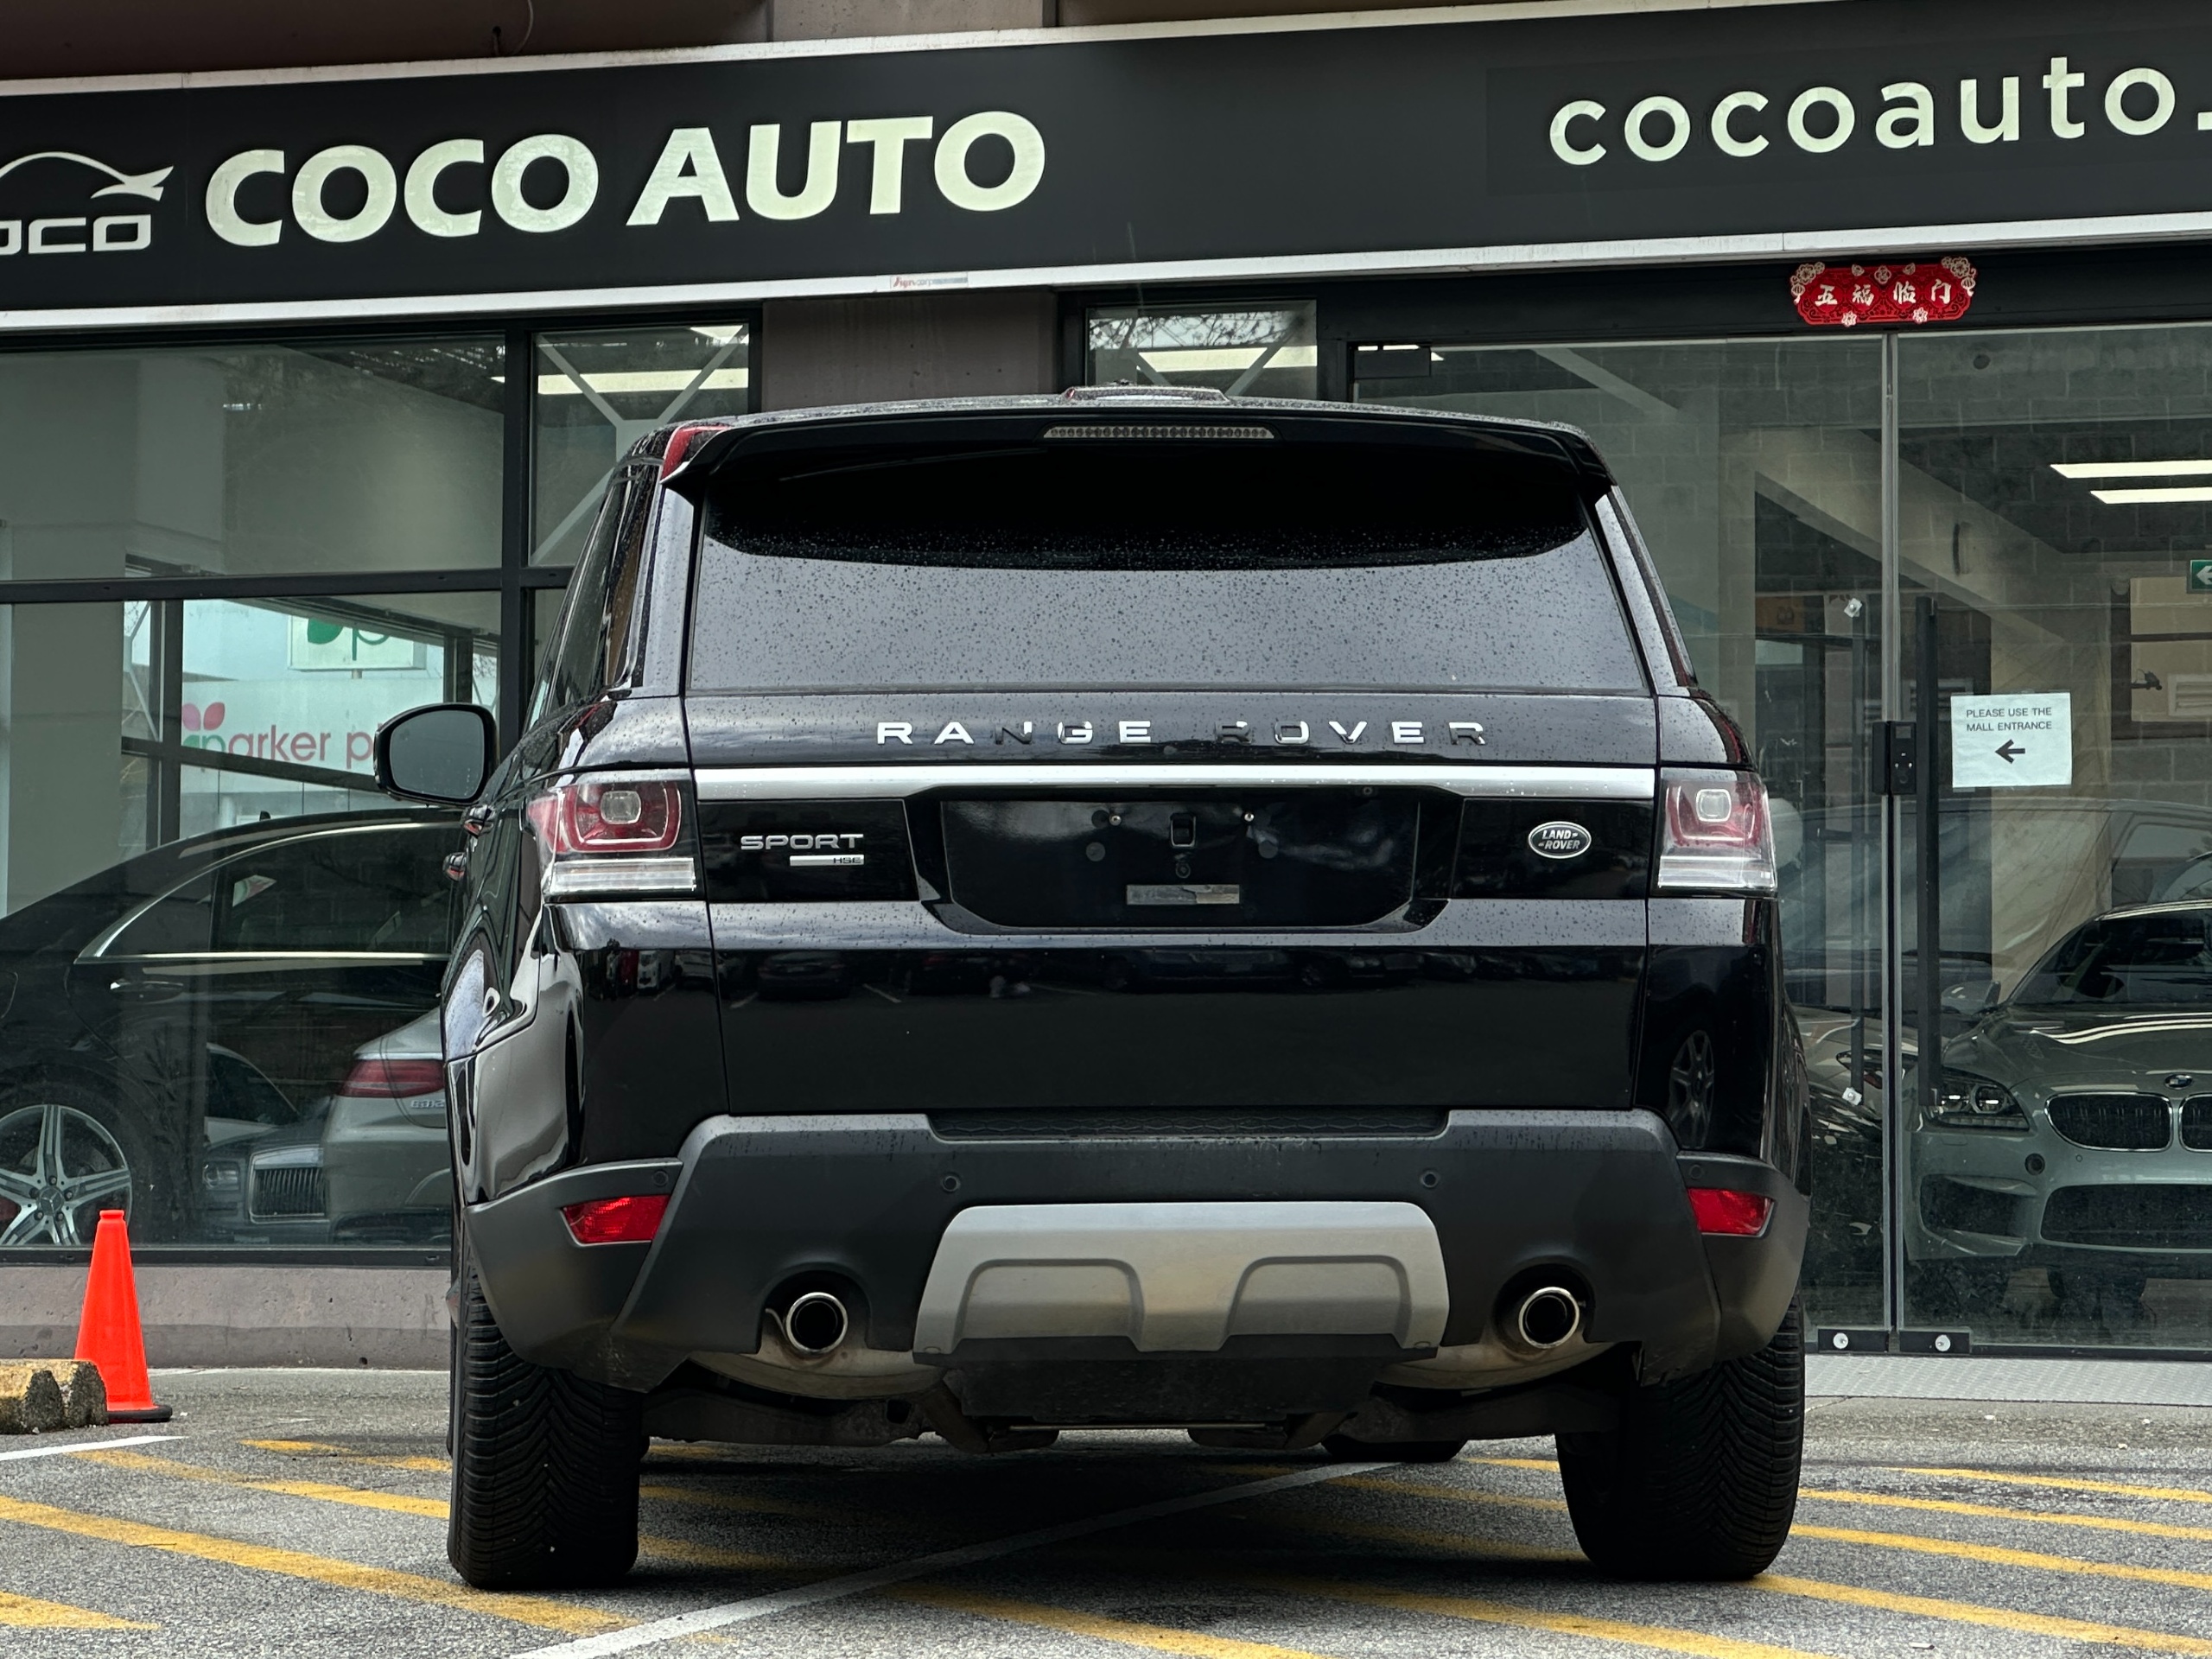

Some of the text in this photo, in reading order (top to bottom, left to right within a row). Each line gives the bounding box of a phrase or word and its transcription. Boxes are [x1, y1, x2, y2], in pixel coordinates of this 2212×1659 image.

[1549, 56, 2212, 166] cocoauto.
[205, 111, 1046, 247] COCO AUTO
[1815, 278, 1952, 307] 五福临门
[1967, 707, 2052, 718] PLEASE USE THE
[876, 721, 1485, 745] RANGE ROVER
[1967, 721, 2052, 732] MALL ENTRANCE
[741, 833, 864, 850] SPORT
[1542, 830, 1572, 840] LAND
[1544, 840, 1580, 849] ROVER
